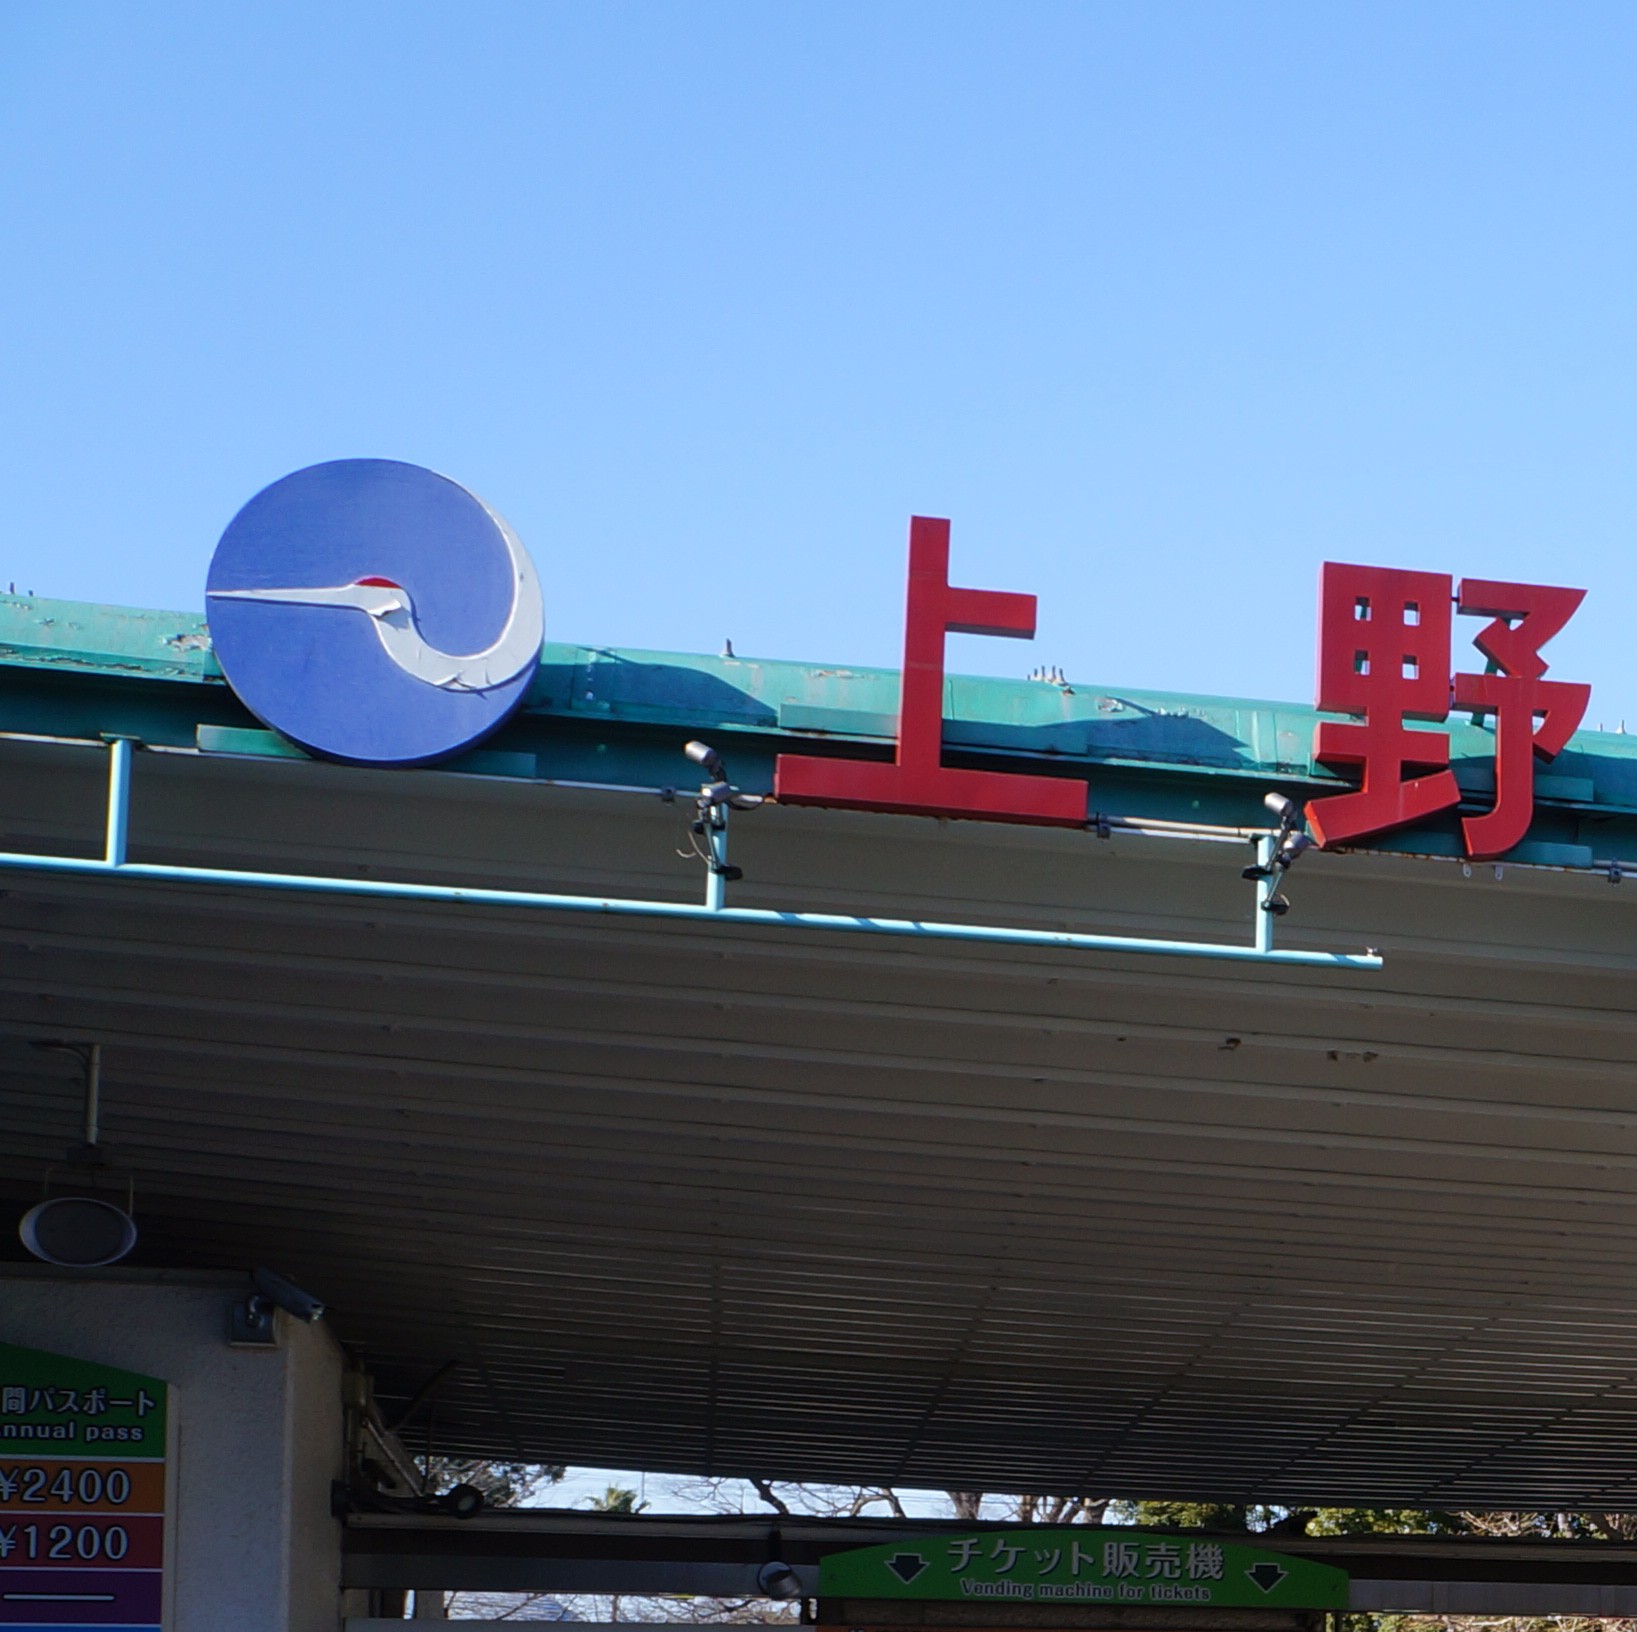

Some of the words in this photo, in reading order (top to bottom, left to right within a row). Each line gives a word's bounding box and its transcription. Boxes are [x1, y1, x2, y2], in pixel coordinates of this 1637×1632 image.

[0, 1423, 75, 1440] nnual
[86, 1426, 143, 1442] pass
[0, 1468, 130, 1503] ¥2400
[0, 1525, 129, 1560] ¥1200
[948, 1539, 1224, 1580] チケット販売機
[961, 1579, 1035, 1598] Vending
[1040, 1582, 1114, 1598] machine
[1119, 1582, 1144, 1600] for
[1151, 1583, 1210, 1601] tickets
